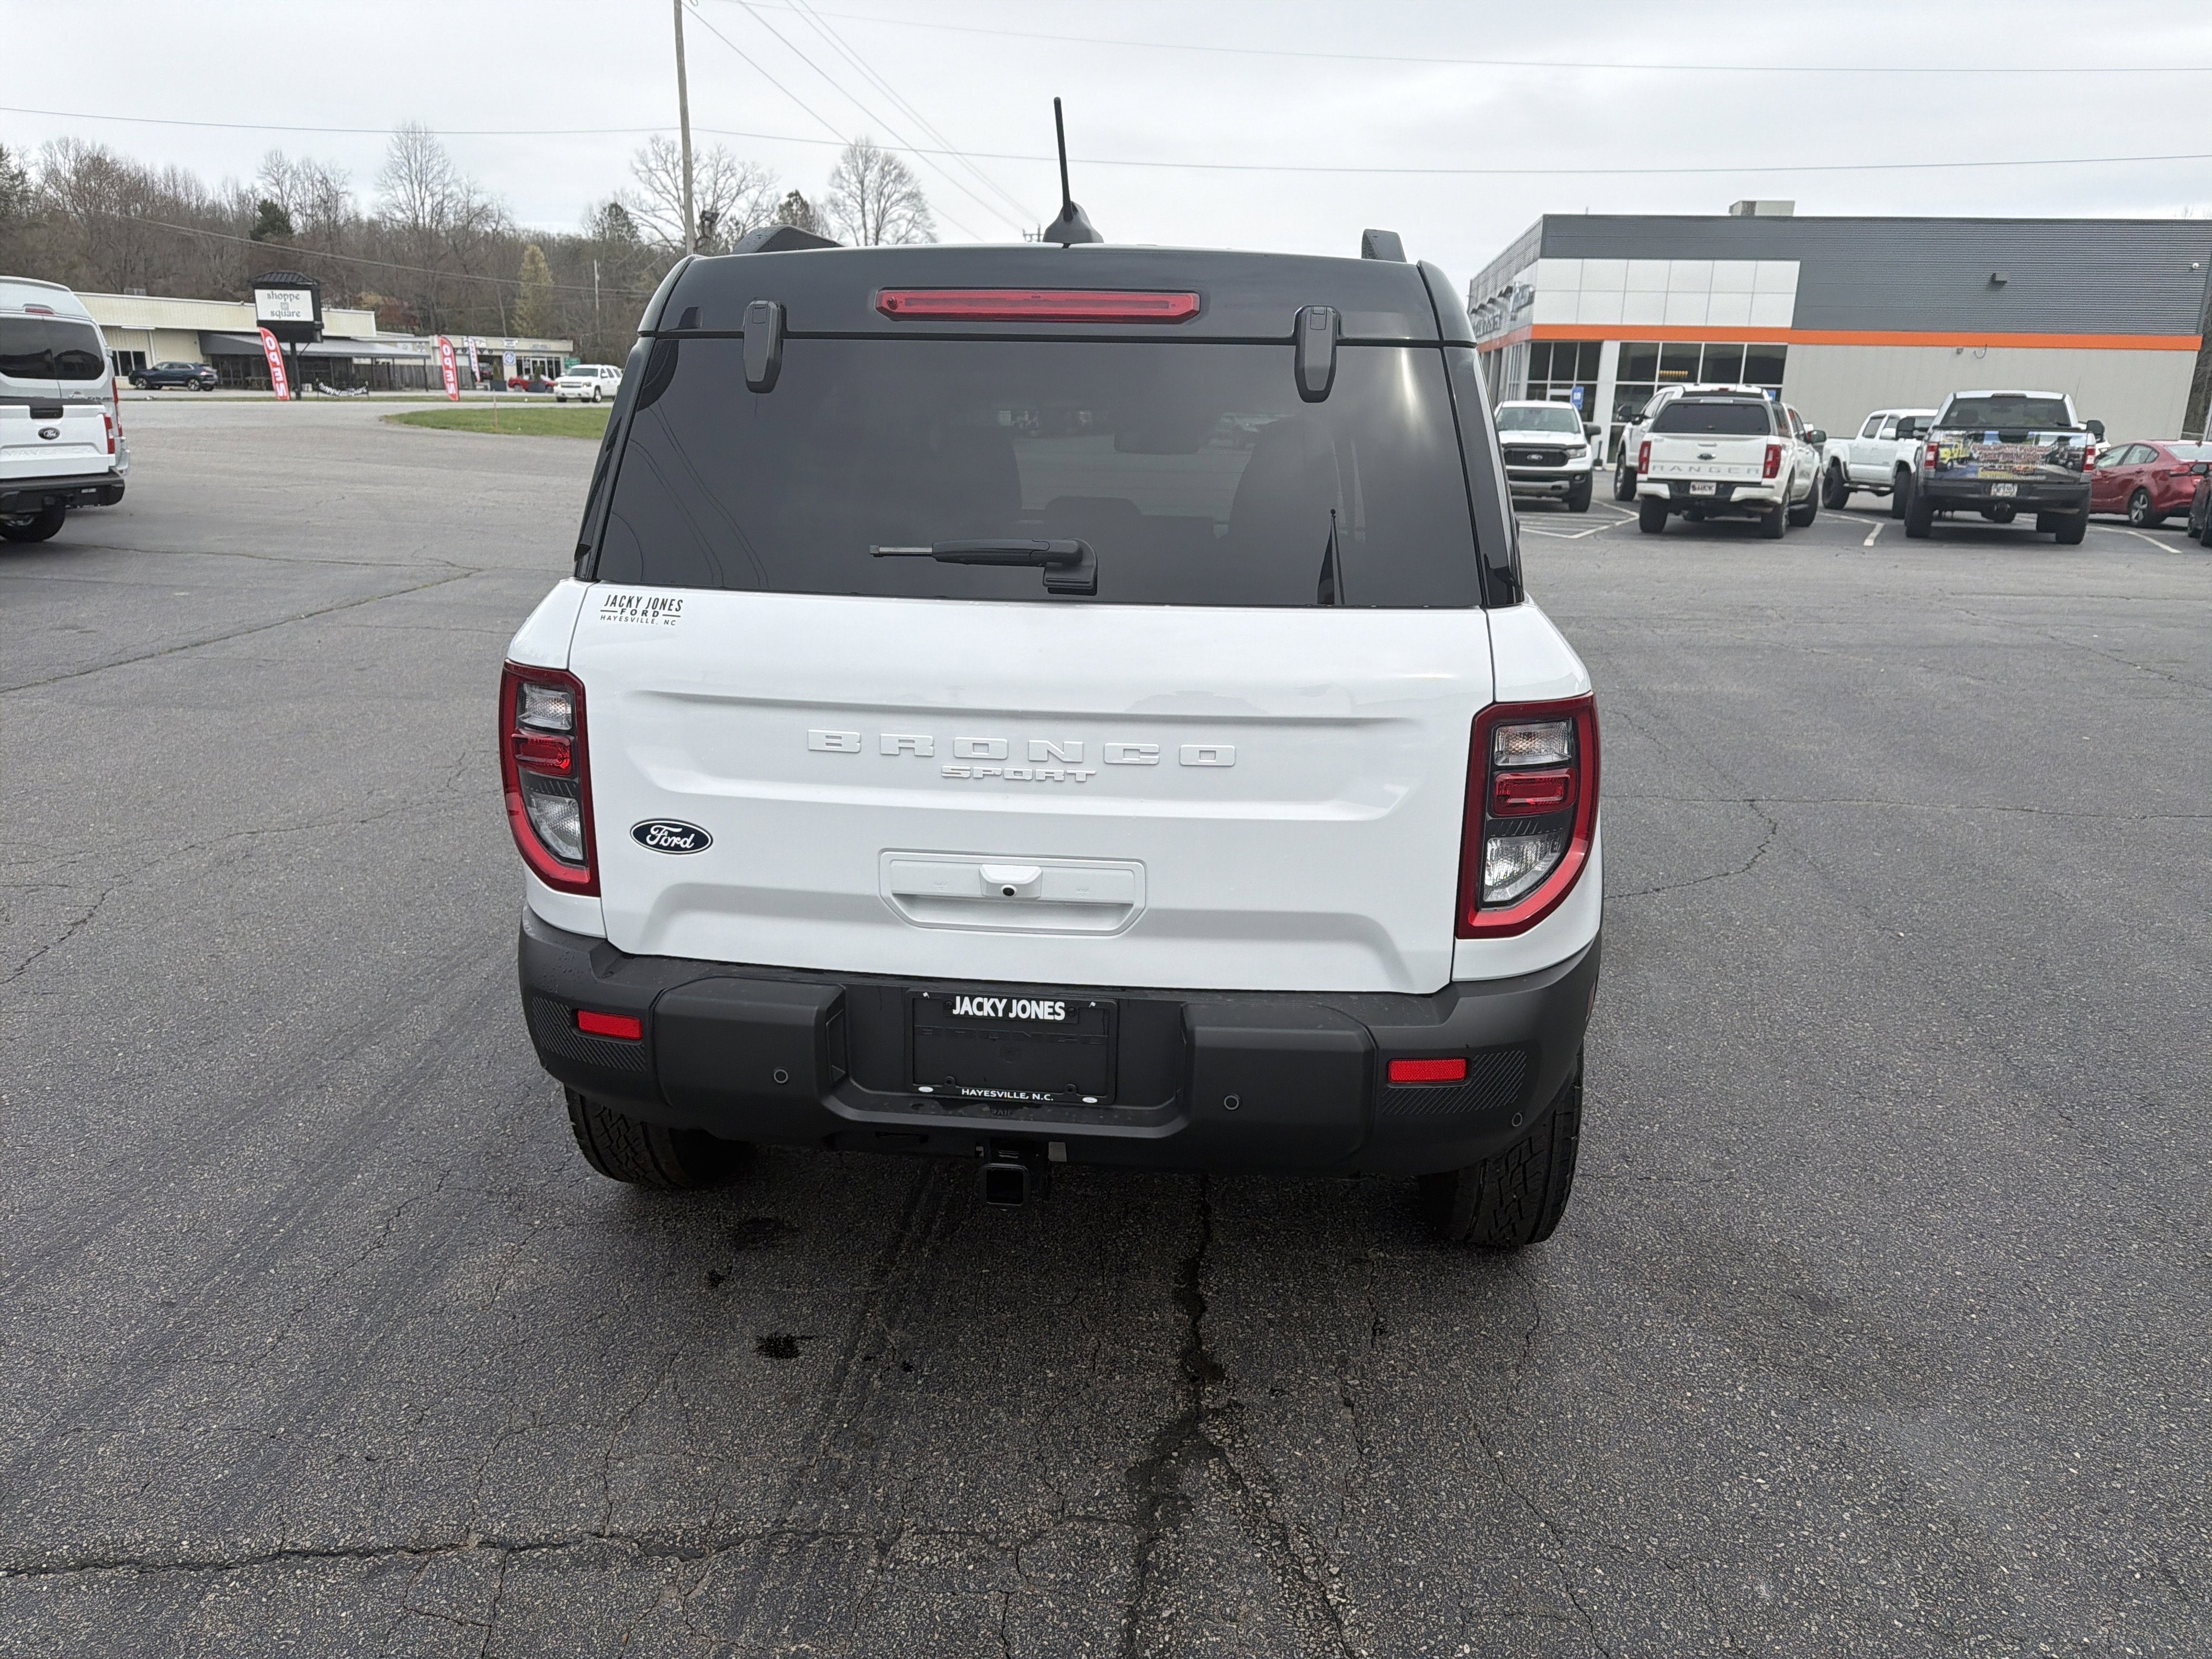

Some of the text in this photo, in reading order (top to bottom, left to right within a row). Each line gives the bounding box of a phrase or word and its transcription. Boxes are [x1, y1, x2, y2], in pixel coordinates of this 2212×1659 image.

[267, 291, 300, 302] shoppe
[270, 309, 301, 318] square
[1652, 465, 1759, 475] RANGER
[604, 595, 683, 612] JACKY JONES
[620, 608, 659, 618] FORD
[807, 729, 1237, 767] BRONCO
[941, 765, 1096, 782] SPORT
[646, 825, 695, 848] Ford
[952, 996, 1065, 1020] JACKY JONES
[962, 1088, 1054, 1101] HAYESVILLE, N.C.
